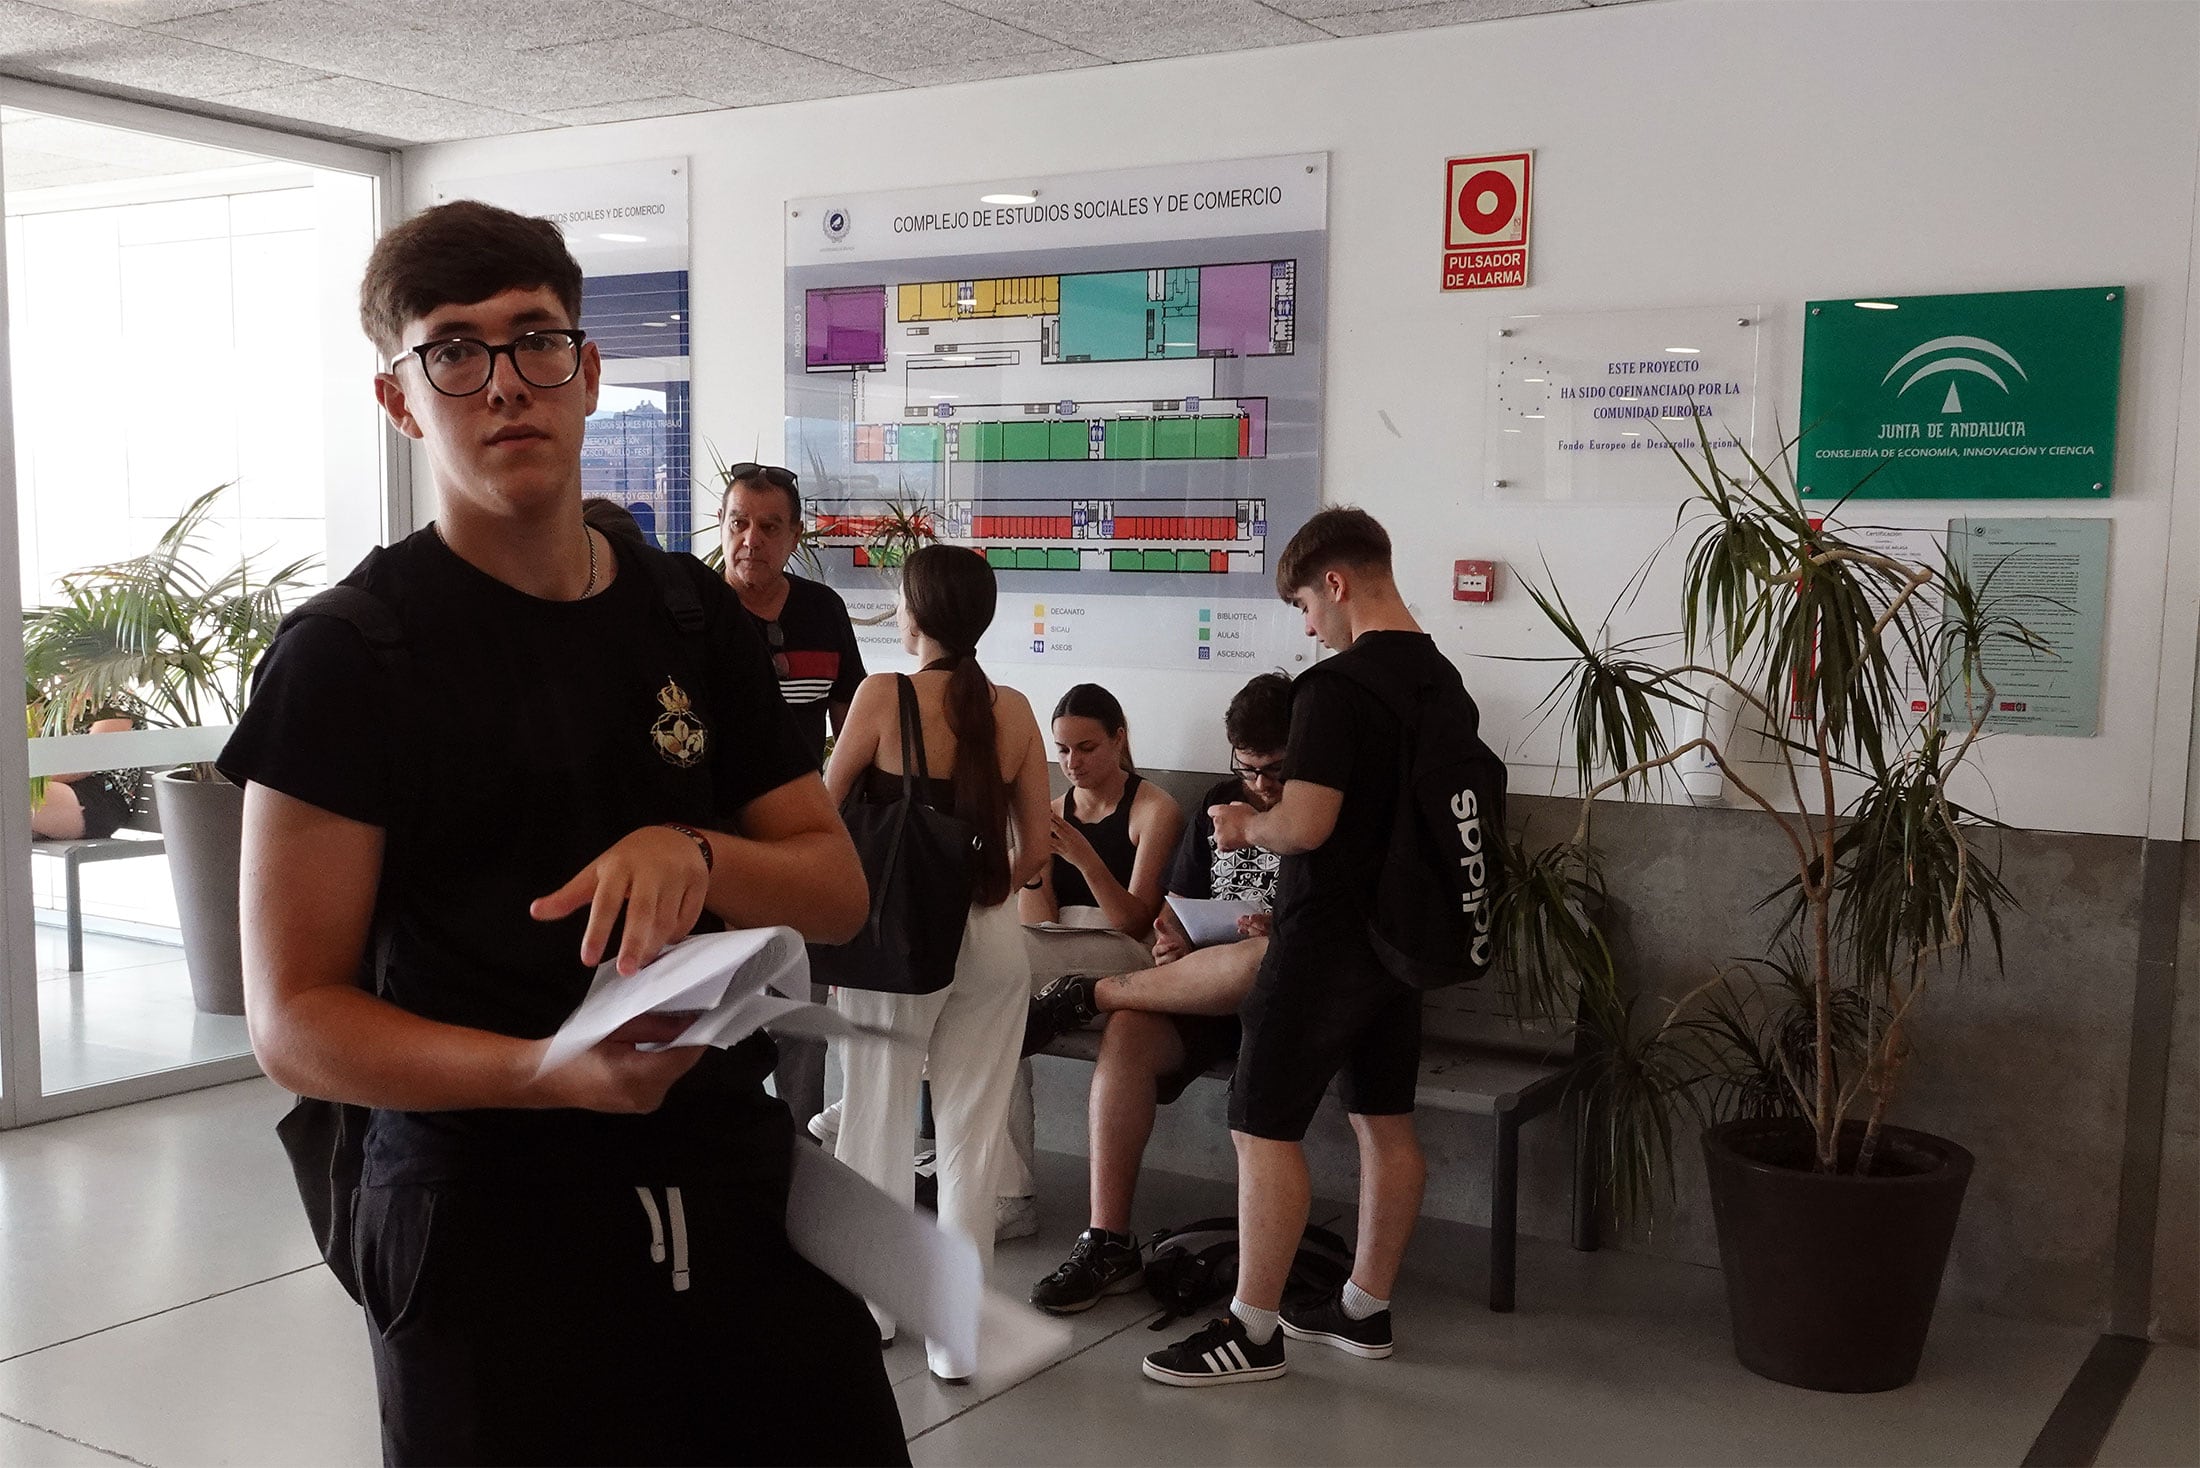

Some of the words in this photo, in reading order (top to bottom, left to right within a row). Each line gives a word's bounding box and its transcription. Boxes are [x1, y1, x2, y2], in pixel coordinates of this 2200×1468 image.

[569, 209, 605, 222] SOCIALES
[606, 209, 612, 219] Y
[613, 208, 623, 218] DE
[624, 204, 665, 217] COMERCIO
[893, 211, 969, 233] COMPLEJO
[972, 209, 992, 227] DE
[996, 204, 1070, 226] ESTUDIOS
[1073, 197, 1148, 220] SOCIALES
[1153, 195, 1165, 213] Y
[1168, 194, 1189, 212] DE
[1193, 186, 1282, 210] COMERCIO
[1449, 253, 1520, 269] PULSADOR
[1446, 273, 1465, 287] DE
[1467, 271, 1521, 285] ALARMA
[1608, 362, 1636, 375] ESTE
[1639, 360, 1699, 374] PROYECTO
[1560, 387, 1576, 399] HA
[1579, 386, 1606, 398] SIDO
[1608, 383, 1695, 398] COFINANCIADO
[1698, 383, 1721, 396] POR
[1725, 383, 1740, 394] LA
[1593, 406, 1659, 420] COMUNIDAD
[1877, 423, 1921, 440] JUNTA
[1926, 422, 1944, 438] DE
[1558, 440, 1584, 450] Fondo
[1589, 439, 1626, 451] Europeo
[1630, 439, 1641, 449] de
[1815, 447, 1879, 458] CONSEJERÍA
[1880, 448, 1895, 458] DE
[1963, 445, 2038, 457] INNOVACIÓN
[2040, 446, 2048, 456] Y
[2048, 445, 2095, 456] CIENCIA
[1050, 607, 1086, 616] DECANATO
[1216, 612, 1258, 621] BIBLIOTECA
[1216, 631, 1240, 639] AULAS
[1050, 644, 1073, 652] ASEOS
[1216, 650, 1256, 659] ASCENSOR
[1450, 788, 1493, 967] adidas
